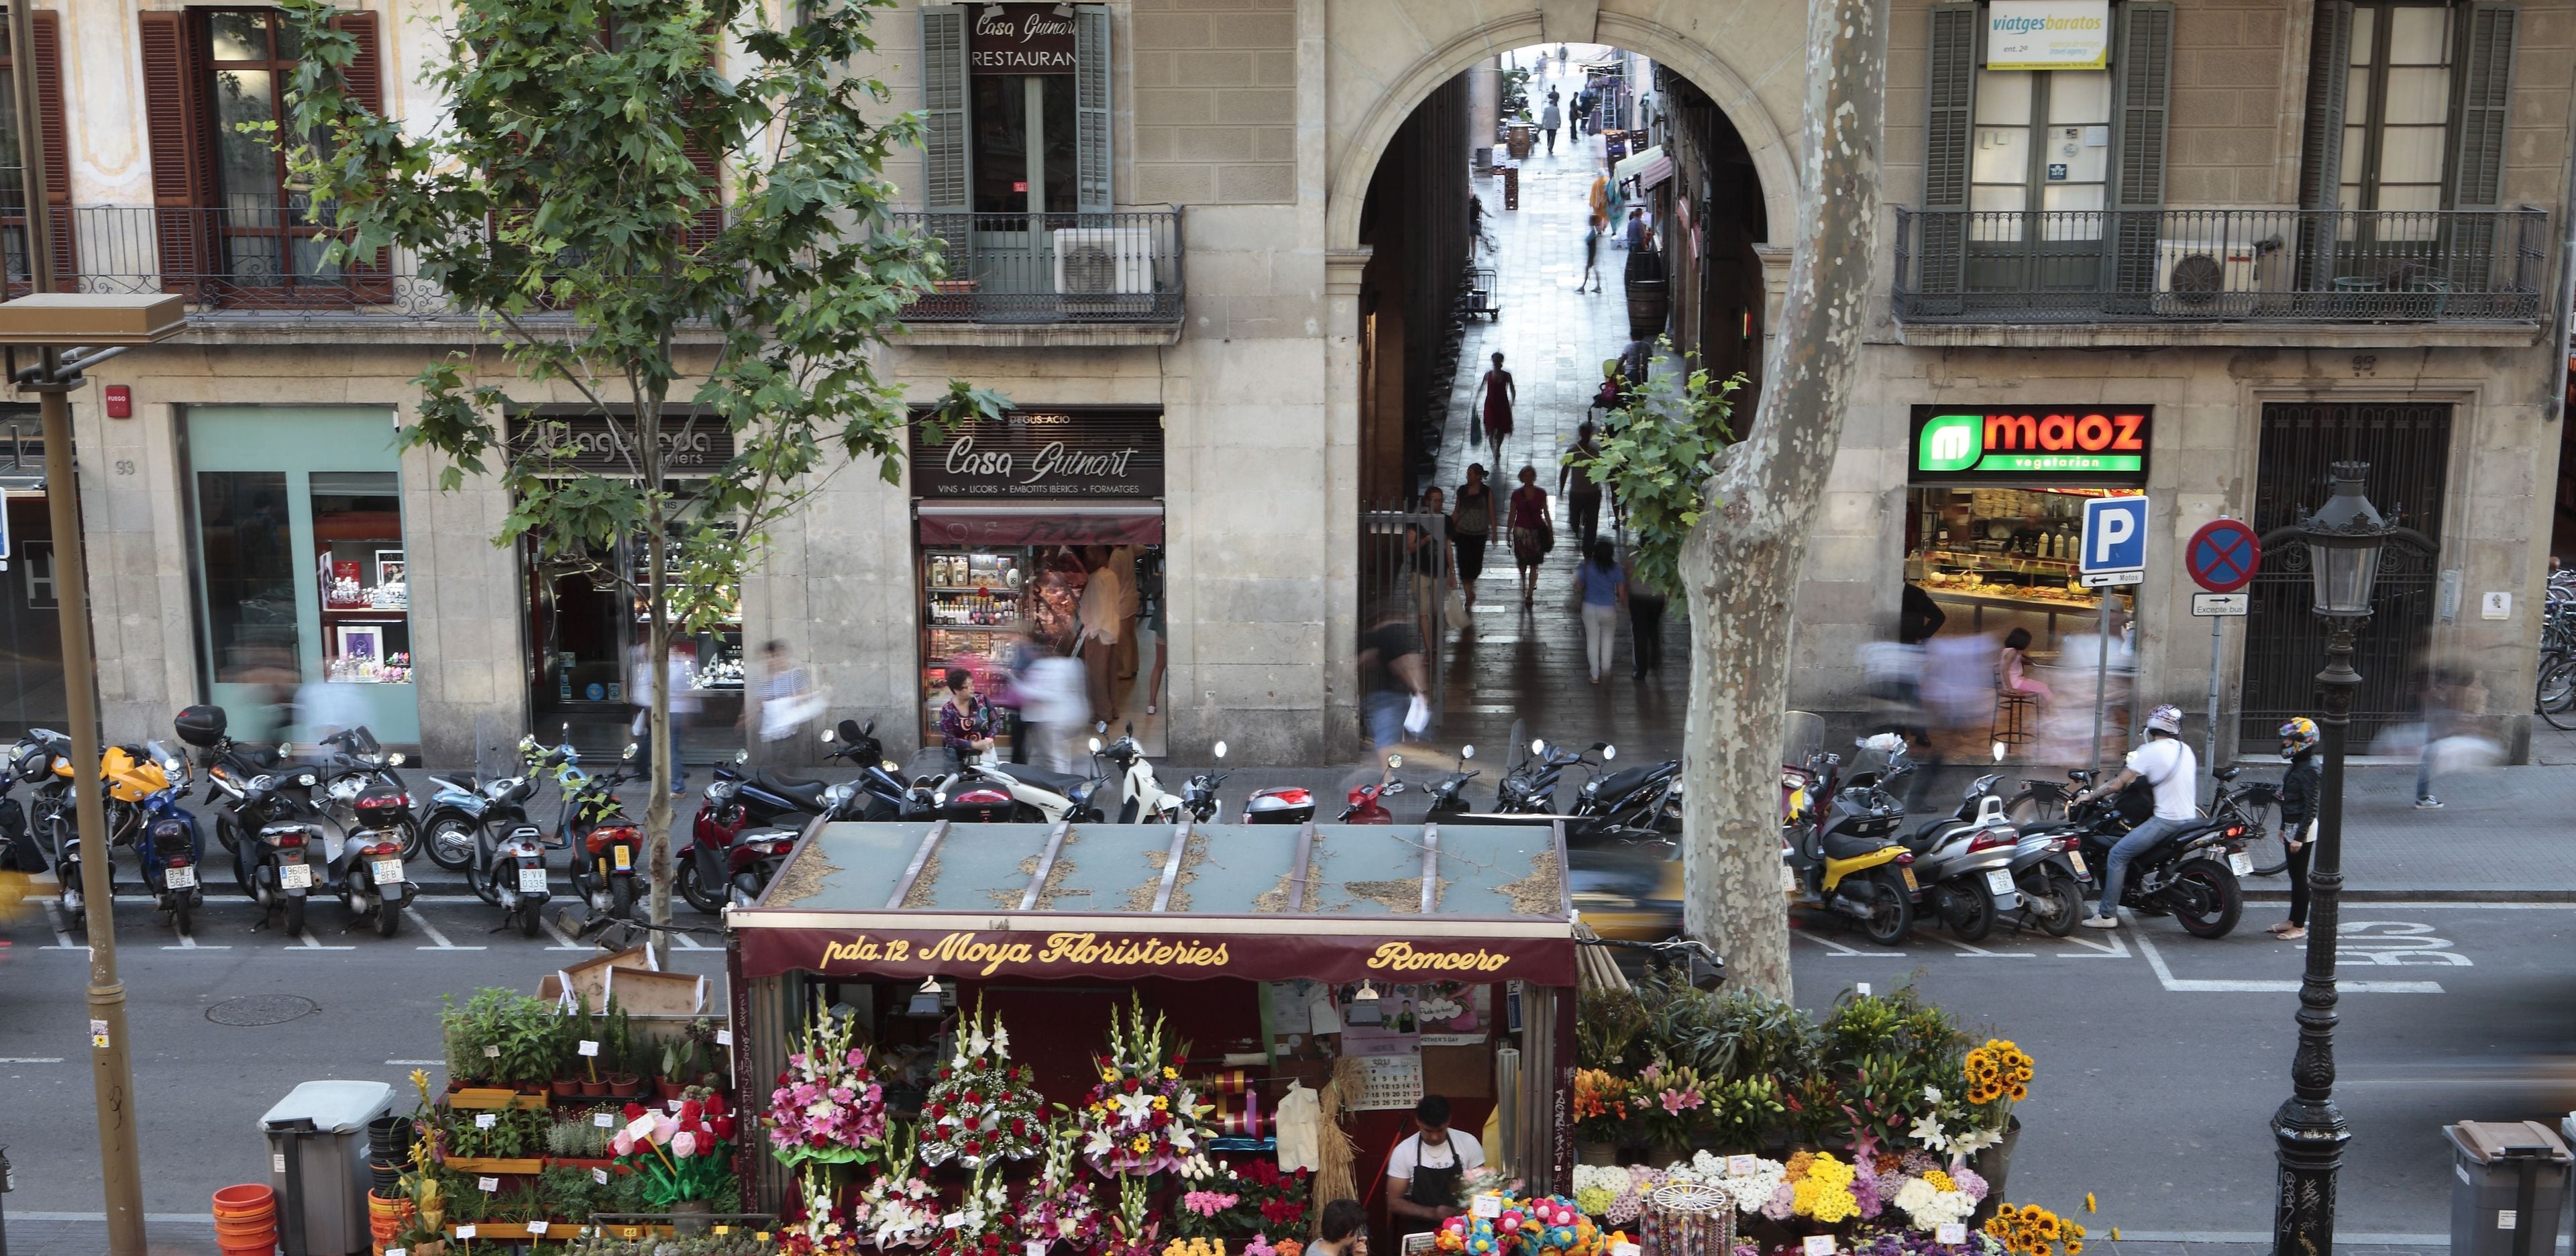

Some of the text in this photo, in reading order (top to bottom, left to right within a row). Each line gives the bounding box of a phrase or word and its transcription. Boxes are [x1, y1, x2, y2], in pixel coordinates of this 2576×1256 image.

[976, 13, 1014, 36] Casa
[1993, 15, 2101, 34] viatgesbaratos
[2067, 48, 2087, 56] agency
[1984, 414, 2145, 451] maoz
[946, 435, 1138, 484] Casa Guinart
[2015, 457, 2100, 470] vegetarian
[116, 460, 135, 475] 93
[938, 485, 958, 493] VINS
[970, 485, 998, 493] LICORS
[1010, 485, 1047, 493] EMBOTITS
[1090, 485, 1139, 493] FORMATGES
[2096, 508, 2135, 563] P
[2119, 574, 2139, 582] Motos
[2197, 606, 2227, 614] Excepte
[287, 866, 308, 875] 9608
[380, 861, 400, 870] 3714
[170, 876, 192, 886] 5664
[288, 876, 304, 885] FBL
[819, 935, 910, 970] pda.12
[918, 932, 1230, 976] Moya Floristeries
[1366, 941, 1511, 972] Roncero
